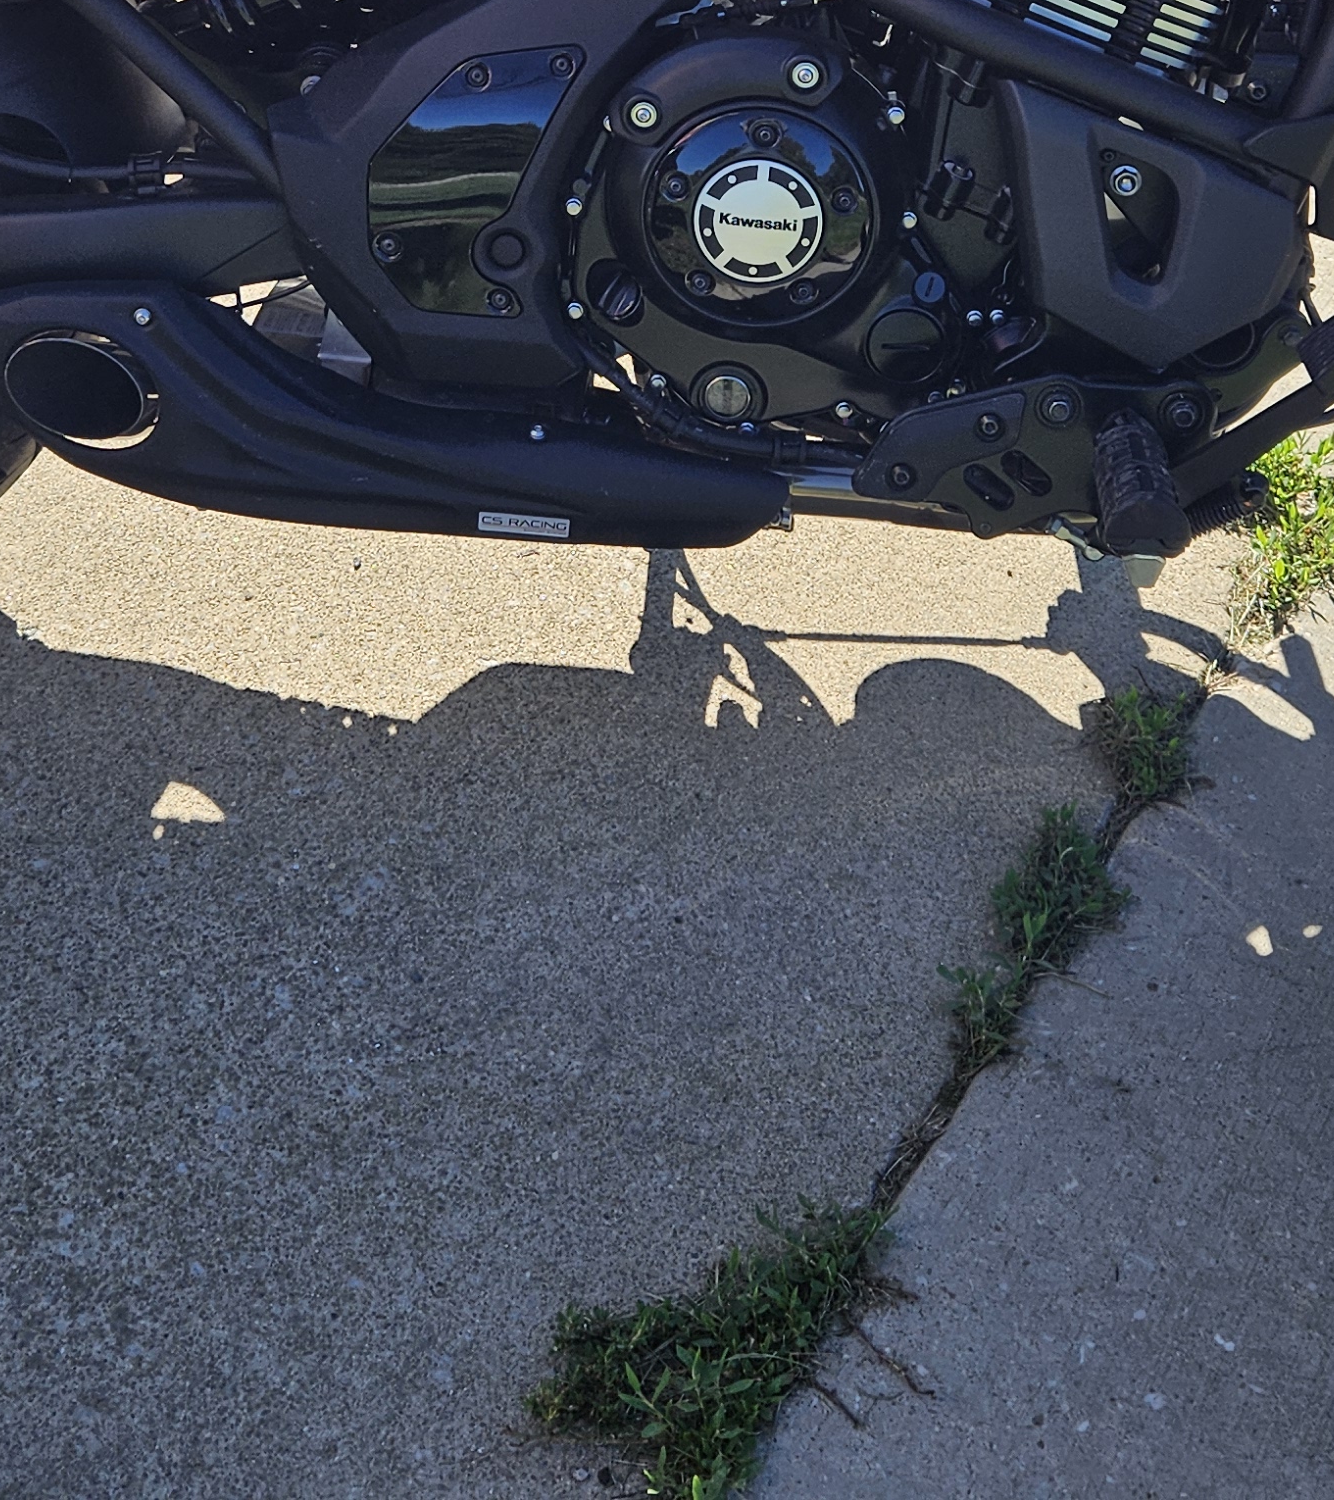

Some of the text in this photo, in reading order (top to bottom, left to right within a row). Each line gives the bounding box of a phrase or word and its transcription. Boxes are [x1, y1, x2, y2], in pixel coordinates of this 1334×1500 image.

[719, 212, 798, 231] Kawasaki
[482, 515, 567, 531] CS RACING
